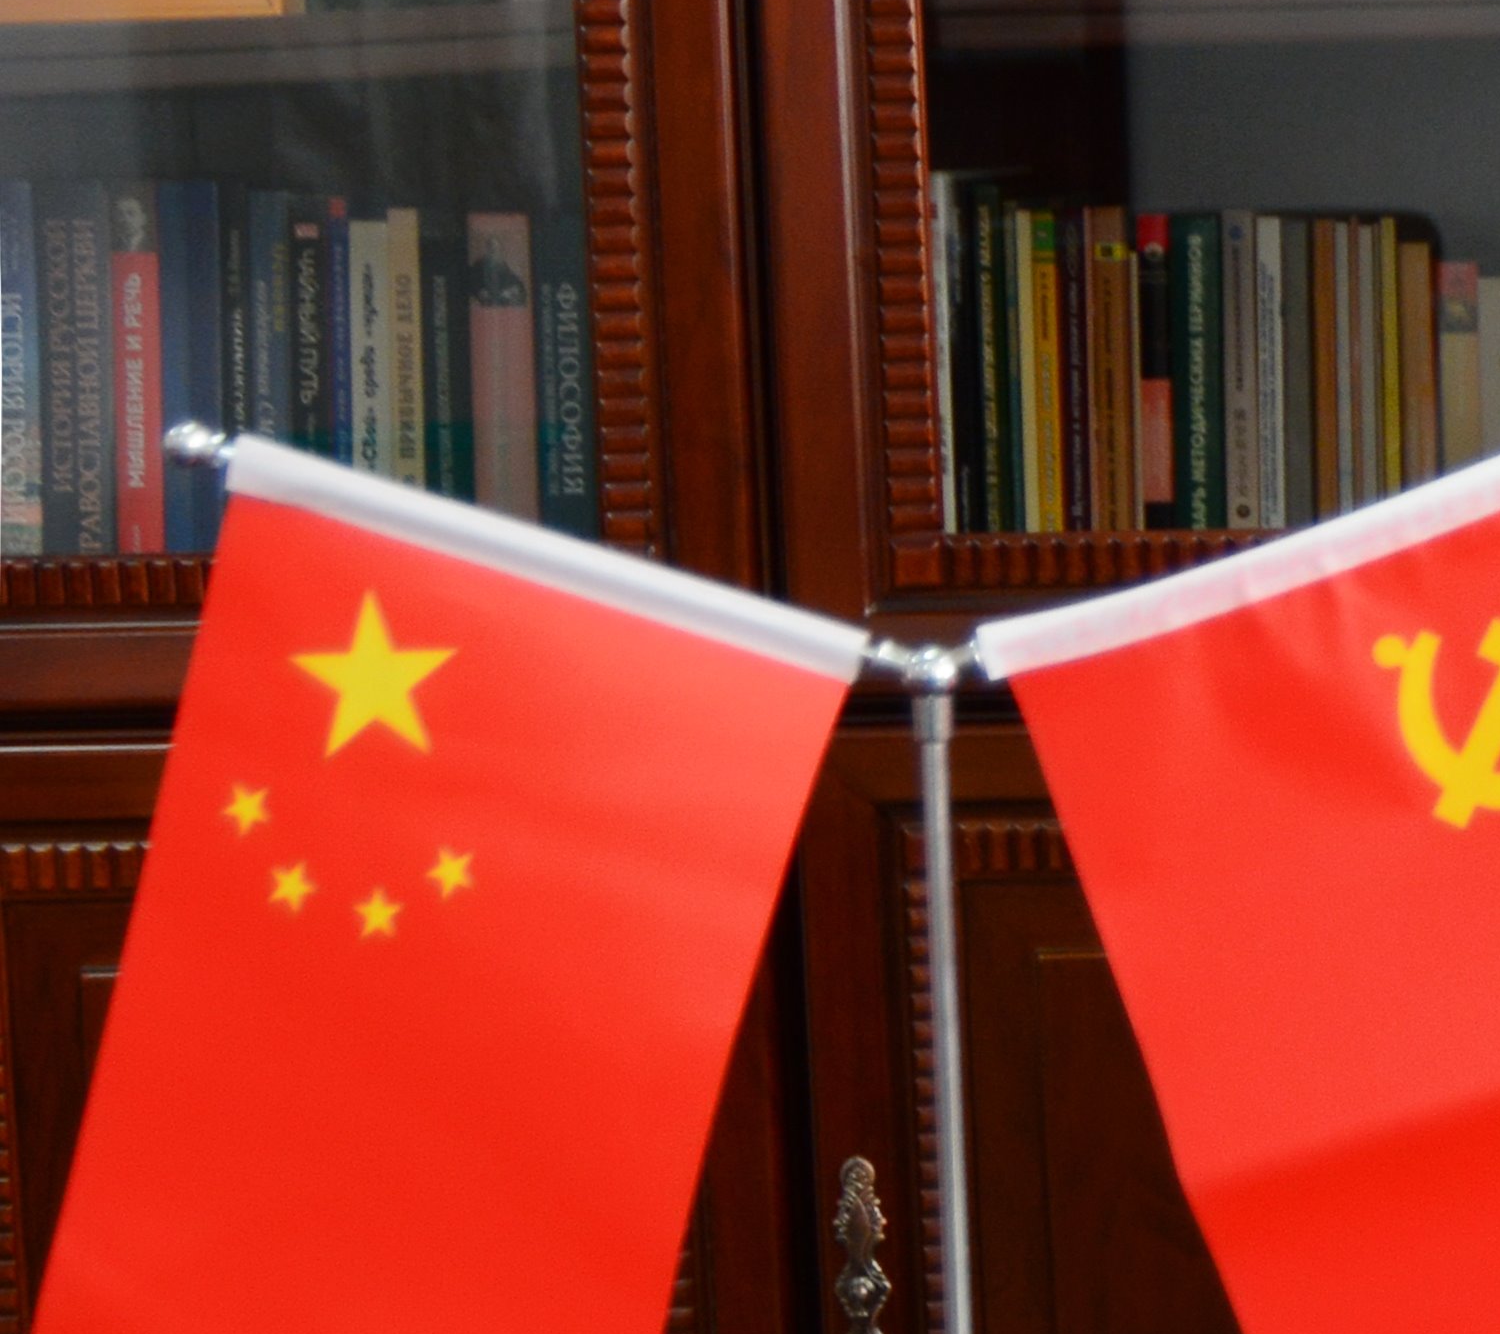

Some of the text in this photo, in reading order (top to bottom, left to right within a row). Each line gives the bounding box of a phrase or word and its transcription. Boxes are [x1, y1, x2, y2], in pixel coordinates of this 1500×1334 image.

[45, 218, 75, 493] ИСТОРИЯ РУССКОЙ
[72, 218, 99, 330] ЦЕРКВИ
[122, 271, 147, 488] МЫШЛЕНИЕ И РЕЧЬ
[554, 282, 585, 497] ФИЛОСОФИЯ
